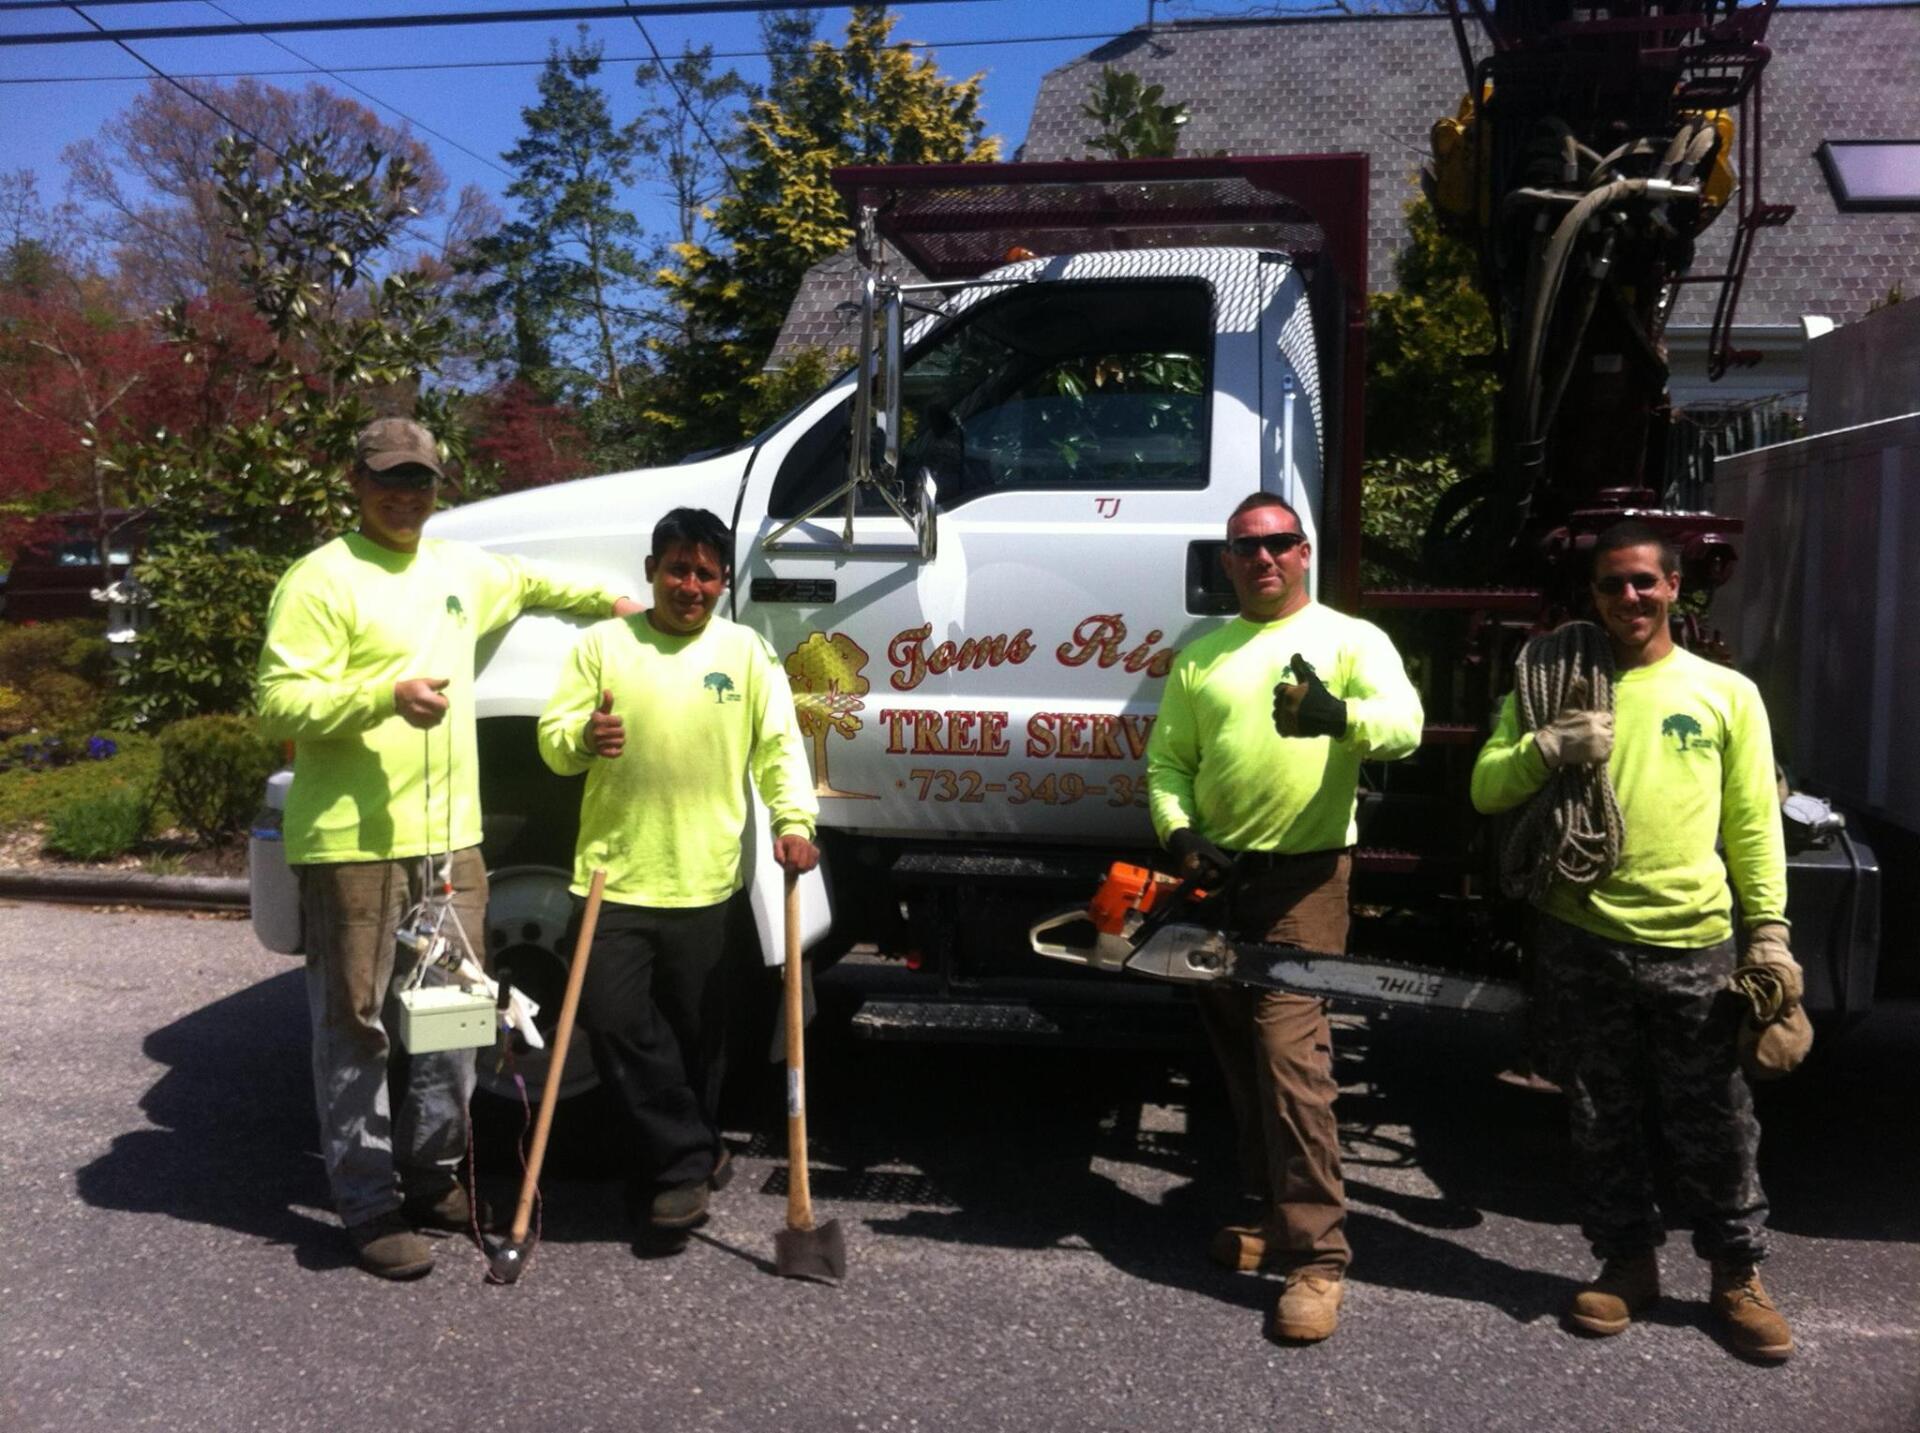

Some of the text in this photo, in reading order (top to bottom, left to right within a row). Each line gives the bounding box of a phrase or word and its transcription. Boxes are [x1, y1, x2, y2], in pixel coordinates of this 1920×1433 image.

[1094, 497, 1121, 519] TJ
[887, 621, 1037, 691] Toms
[879, 708, 1010, 757] TREE
[1375, 975, 1443, 997] STIHL
